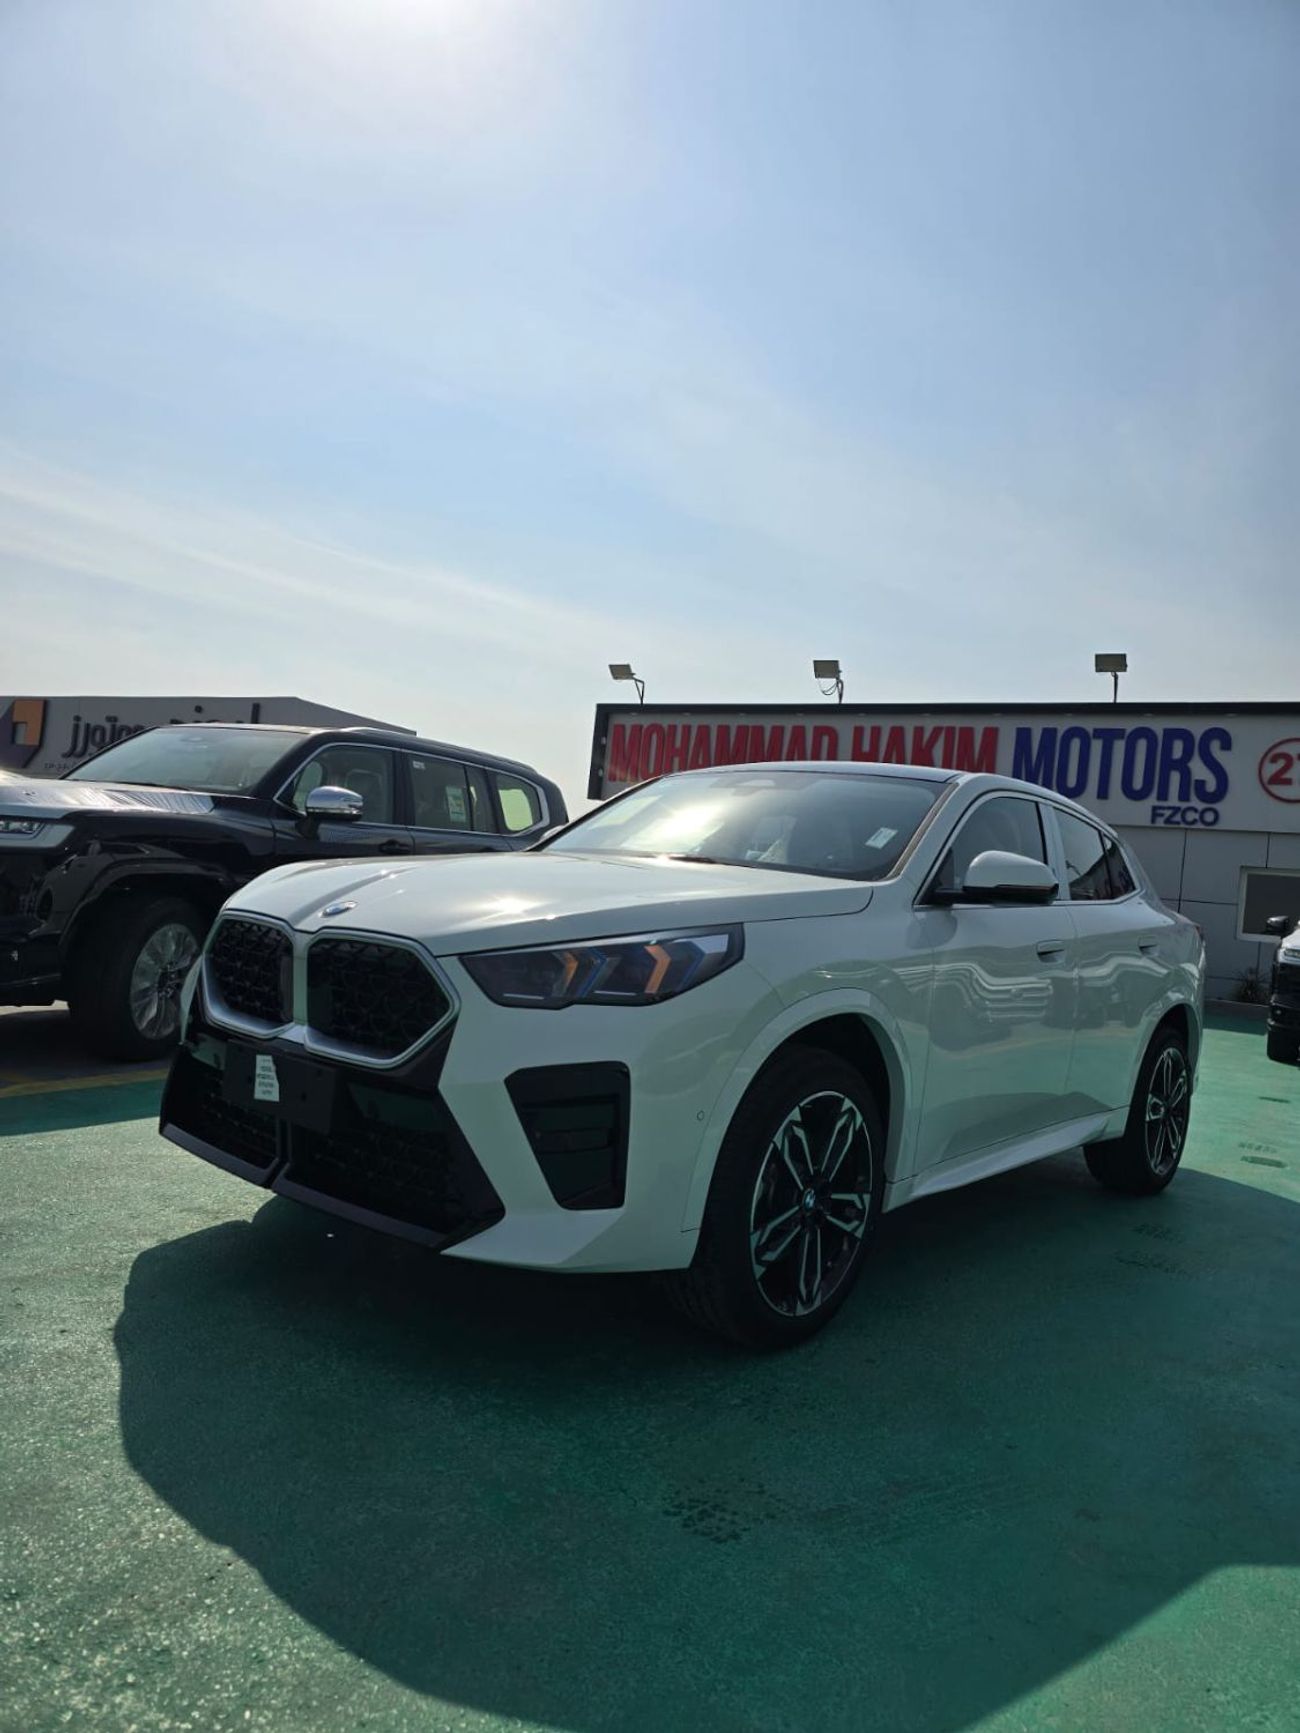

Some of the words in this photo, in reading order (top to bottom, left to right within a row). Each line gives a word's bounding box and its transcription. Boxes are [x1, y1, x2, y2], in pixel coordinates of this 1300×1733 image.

[61, 714, 146, 758] وتورز
[608, 723, 839, 782] MOHAMMAD
[851, 725, 999, 773] HAKIM
[1012, 726, 1232, 804] MOTORS
[1267, 752, 1300, 785] 2
[1151, 805, 1220, 827] FZCO
